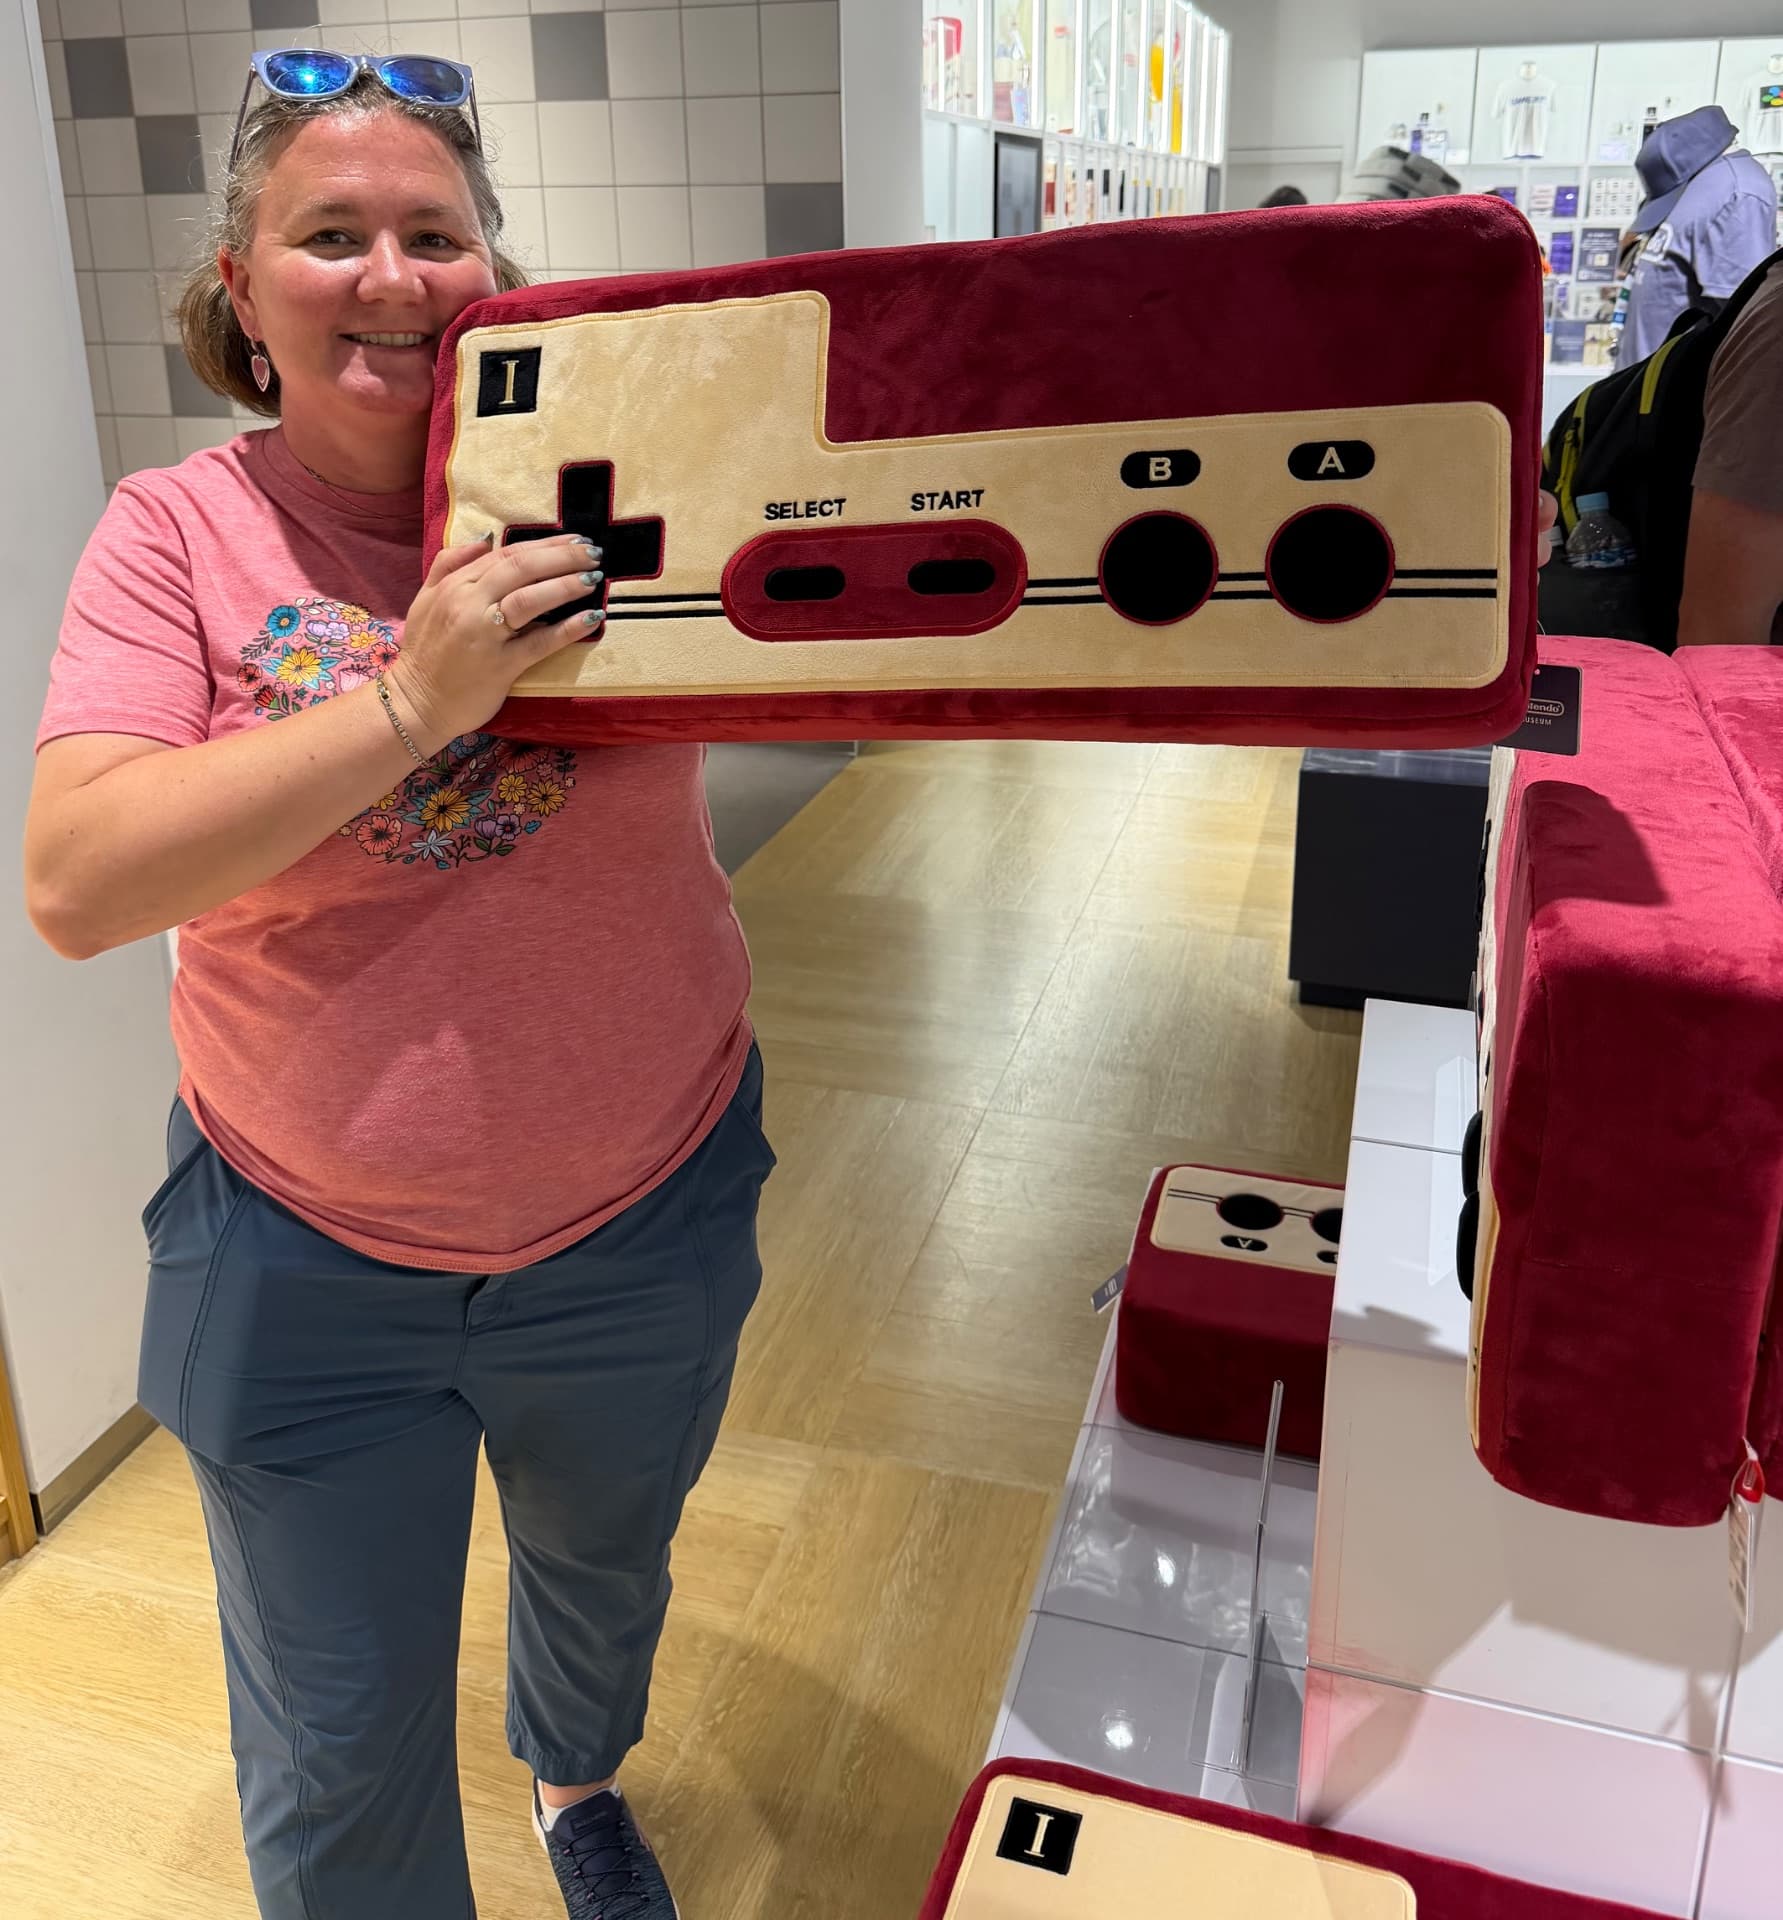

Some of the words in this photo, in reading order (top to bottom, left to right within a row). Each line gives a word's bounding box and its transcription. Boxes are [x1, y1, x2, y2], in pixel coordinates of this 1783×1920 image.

[500, 360, 520, 405] I
[1149, 457, 1172, 481] B
[1318, 446, 1345, 474] A
[764, 498, 847, 521] SELECT
[910, 489, 985, 512] START
[1528, 702, 1560, 713] tendo
[1523, 716, 1552, 726] USEUM
[1237, 1237, 1253, 1249] A
[1024, 1812, 1054, 1858] I
